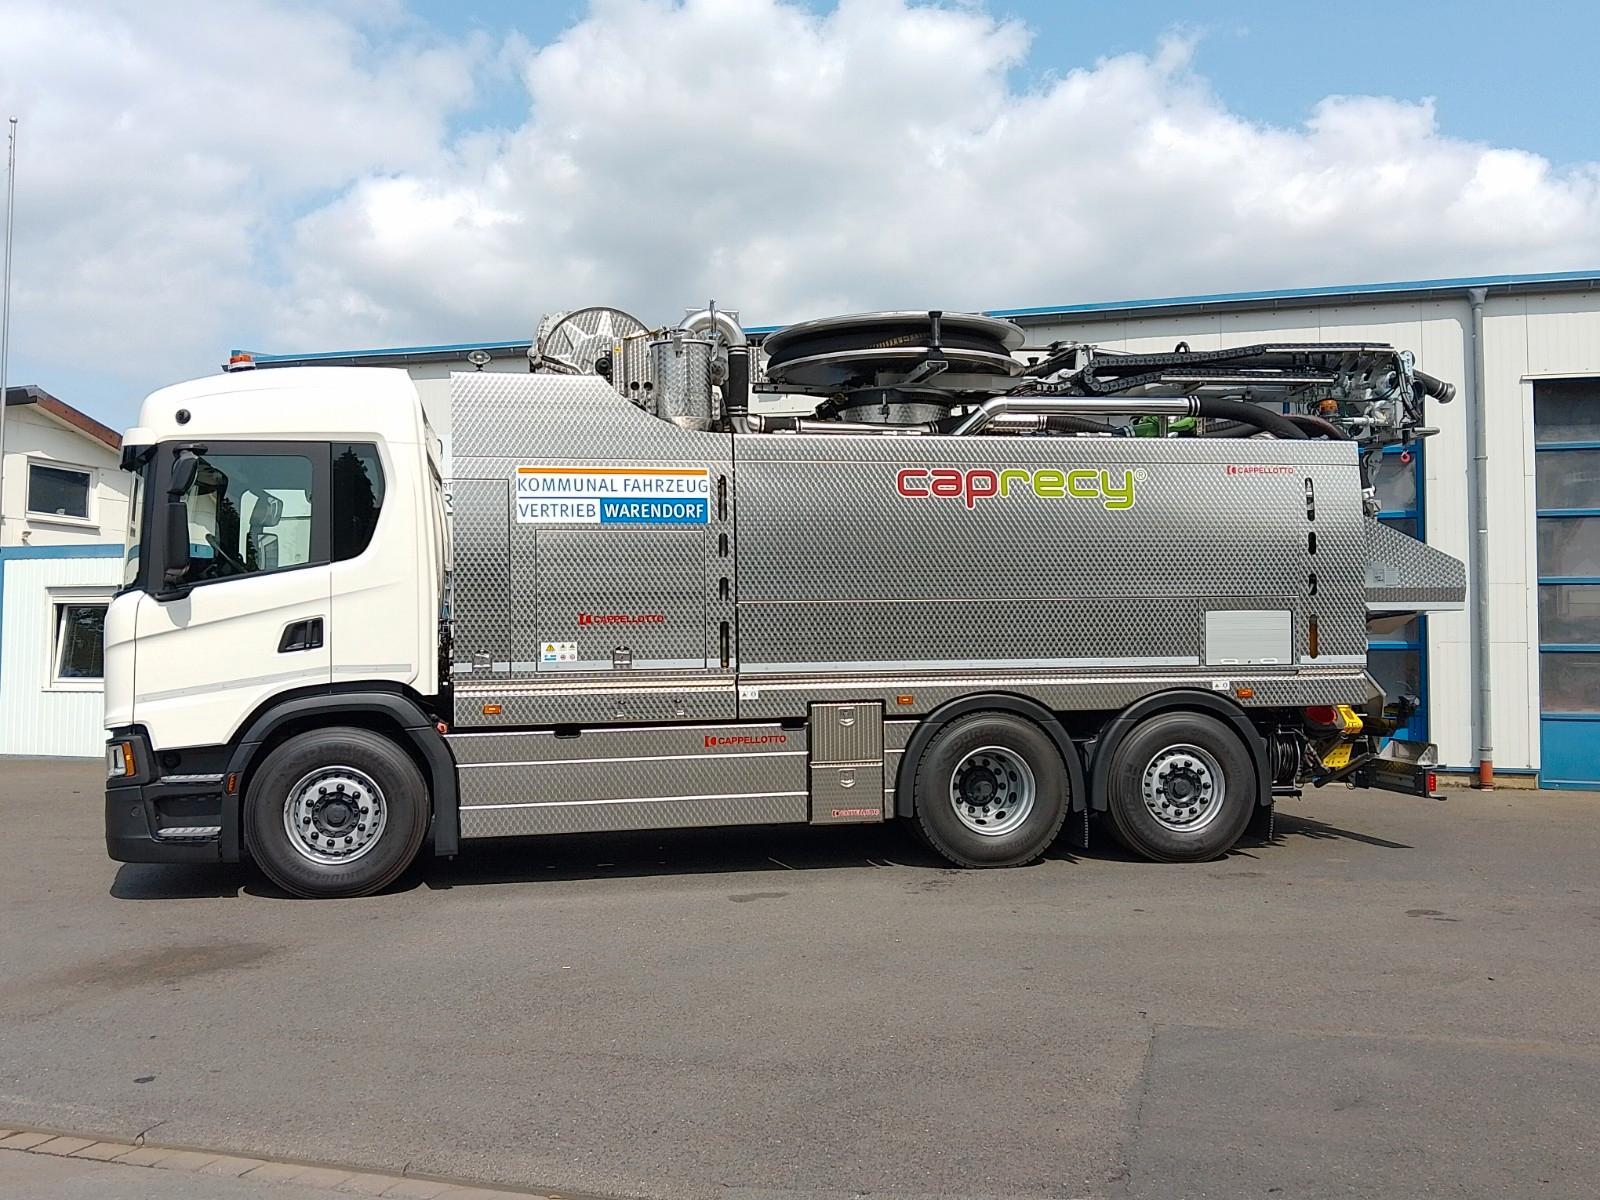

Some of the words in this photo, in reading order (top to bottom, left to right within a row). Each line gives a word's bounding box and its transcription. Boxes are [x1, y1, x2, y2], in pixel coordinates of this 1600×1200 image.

[1237, 466, 1294, 474] CAPPELLOTTO
[517, 477, 618, 492] KOMMUNAL
[623, 479, 709, 493] FAHRZEUG
[518, 503, 596, 518] VERTRIEB
[604, 503, 704, 518] WARENDORF
[594, 614, 664, 624] CAPPELLOTTO
[718, 735, 786, 745] CAPPELLOTTO
